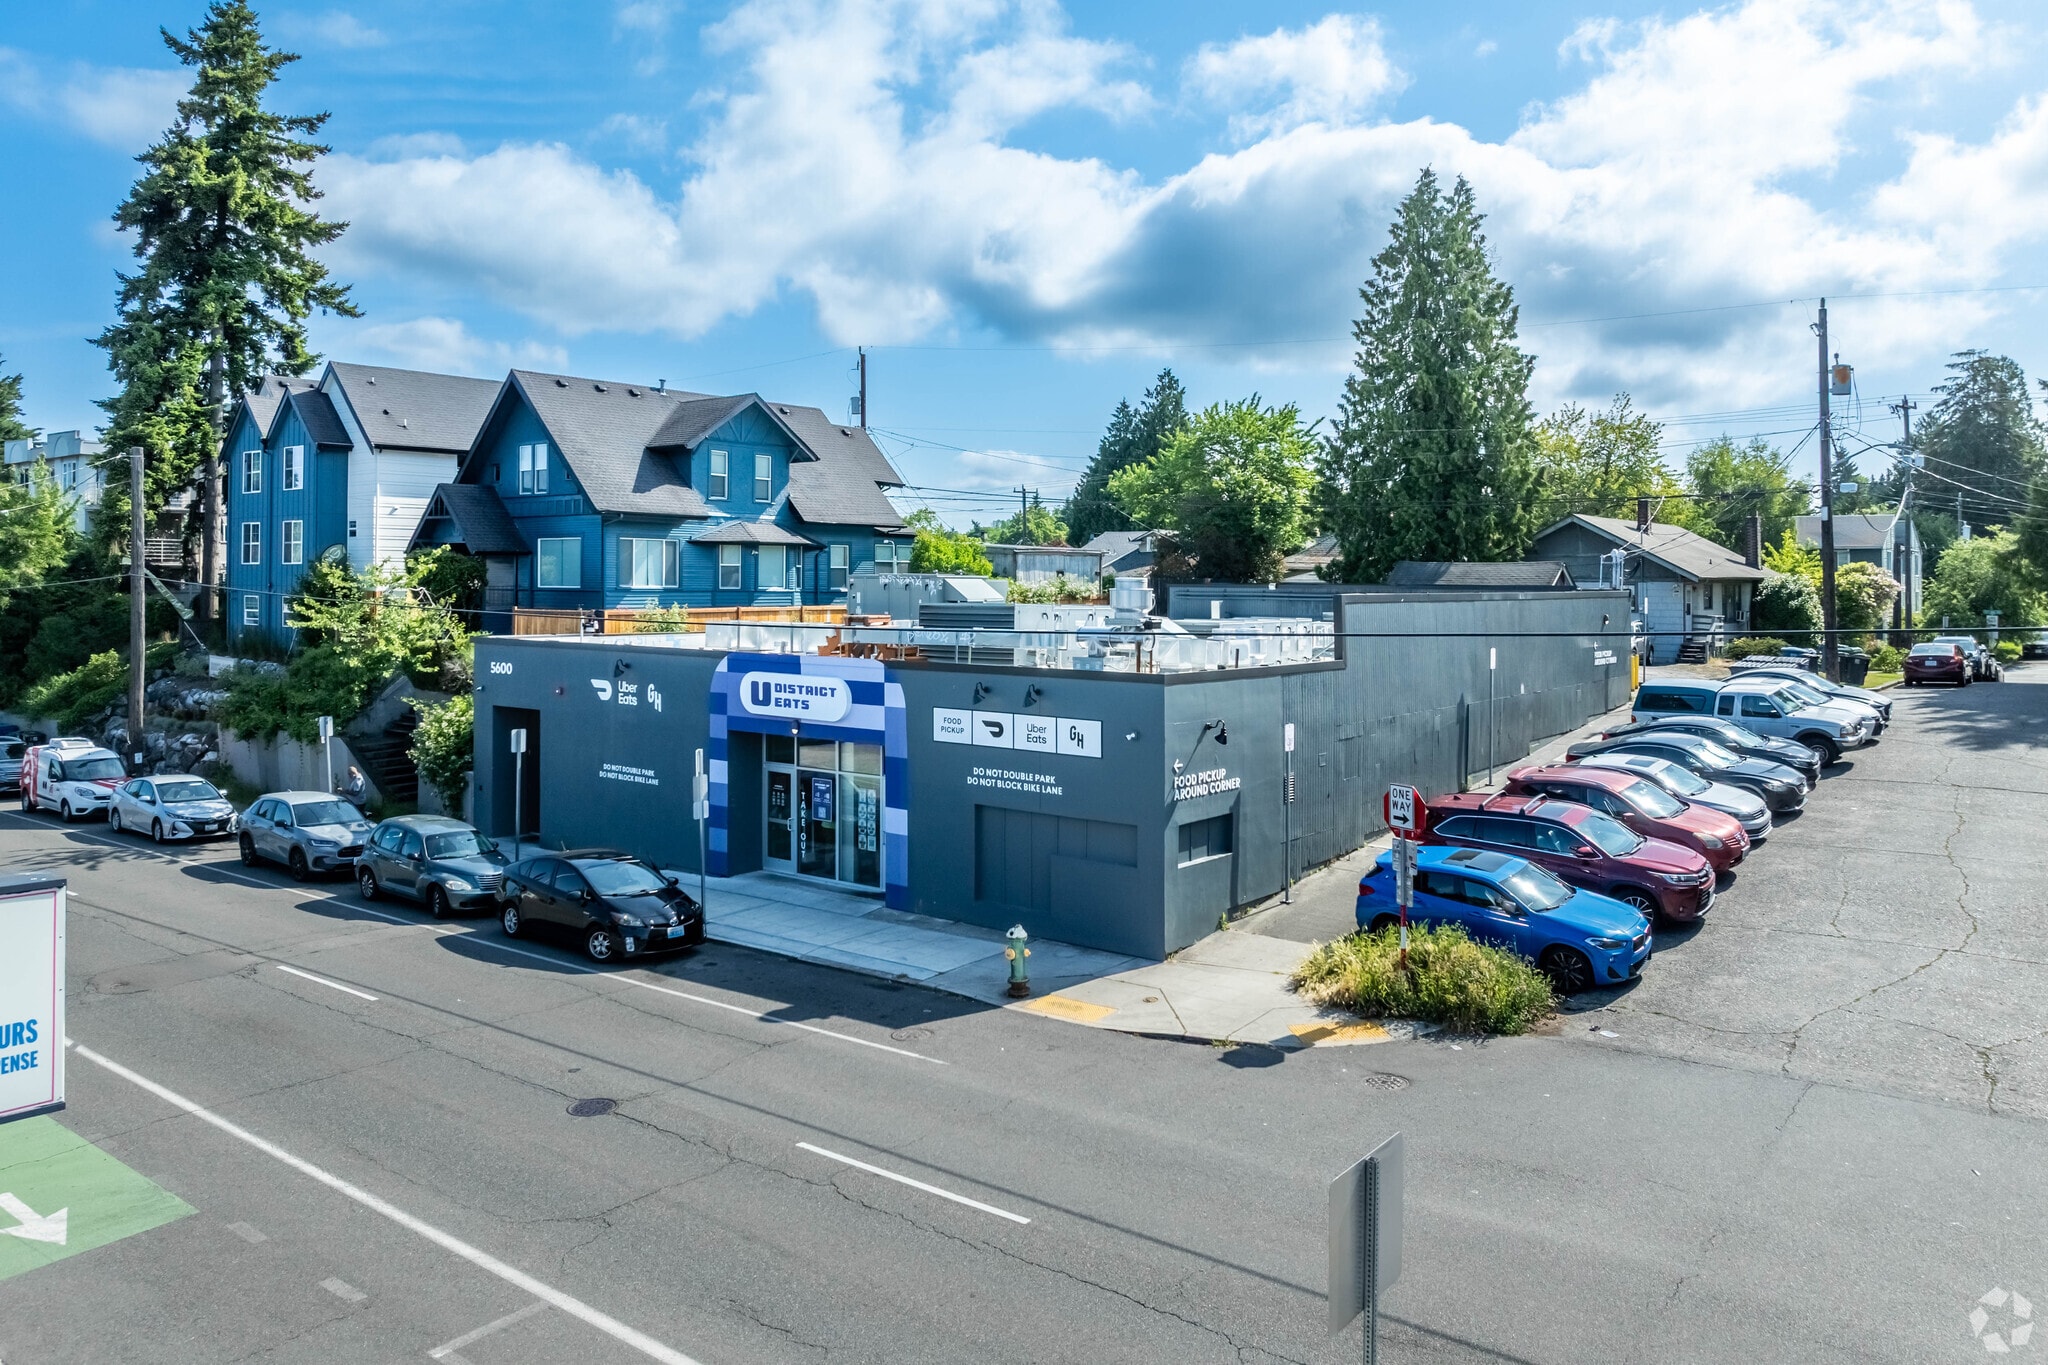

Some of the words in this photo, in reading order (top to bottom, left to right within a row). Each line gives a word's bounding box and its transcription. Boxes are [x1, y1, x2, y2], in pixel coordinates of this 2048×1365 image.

[490, 661, 513, 675] 5600
[618, 680, 638, 693] Uber
[751, 680, 771, 706] U
[774, 683, 837, 698] DISTRICT
[618, 693, 638, 706] Eats
[647, 683, 662, 712] GH
[774, 697, 810, 710] EATS
[943, 716, 962, 725] FOOD
[940, 726, 965, 735] PICKUP
[1026, 723, 1047, 734] Uber
[1026, 733, 1047, 745] Eats
[1069, 725, 1084, 749] GH
[599, 770, 607, 778] DO
[618, 773, 634, 782] BLOCK
[645, 777, 659, 786] LANE
[622, 766, 641, 775] DOUBLE
[641, 768, 655, 777] PARK
[973, 767, 985, 775] DO
[985, 768, 1002, 777] NOT
[1003, 770, 1034, 782] DOUBLE
[1034, 773, 1056, 784] PARK
[1174, 773, 1197, 789] FOOD
[1198, 768, 1227, 784] PICKUP
[967, 776, 979, 785] DO
[979, 778, 996, 787] NOT
[997, 780, 1022, 790] BLOCK
[1023, 783, 1040, 792] BIKE
[1041, 785, 1063, 795] LANE
[1174, 784, 1209, 801] AROUND
[1209, 777, 1241, 794] CORNER
[1392, 788, 1411, 801] ONE
[1391, 799, 1411, 813] WAY
